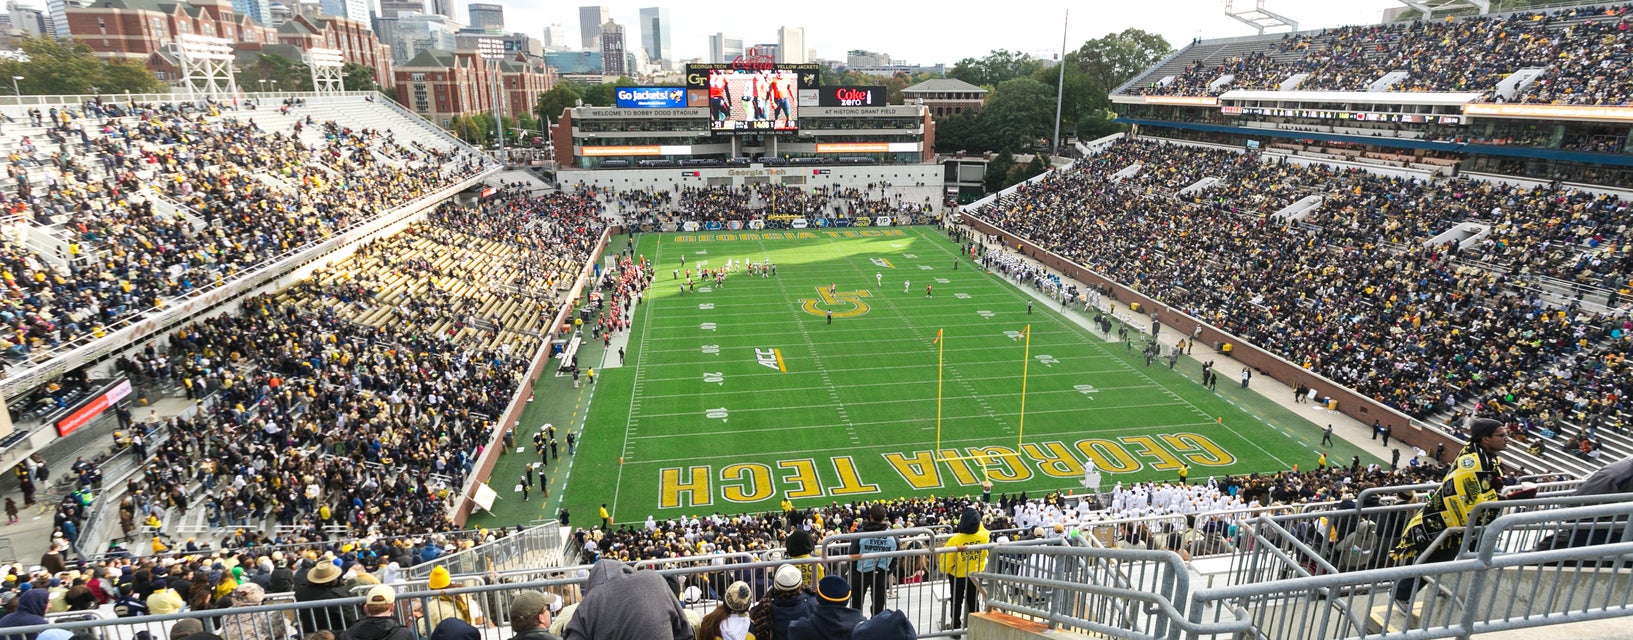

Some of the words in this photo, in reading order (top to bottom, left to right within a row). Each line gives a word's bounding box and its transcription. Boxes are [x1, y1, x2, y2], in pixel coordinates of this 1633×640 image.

[618, 90, 632, 100] Go
[633, 90, 669, 101] Jackets!
[836, 88, 867, 100] Coke
[728, 169, 763, 178] Georgia
[822, 229, 909, 240] TECH
[754, 347, 780, 371] ACC
[705, 406, 729, 419] 10
[881, 432, 1237, 491] GEORGIA
[657, 456, 882, 509] TECH
[869, 538, 888, 546] EVENT
